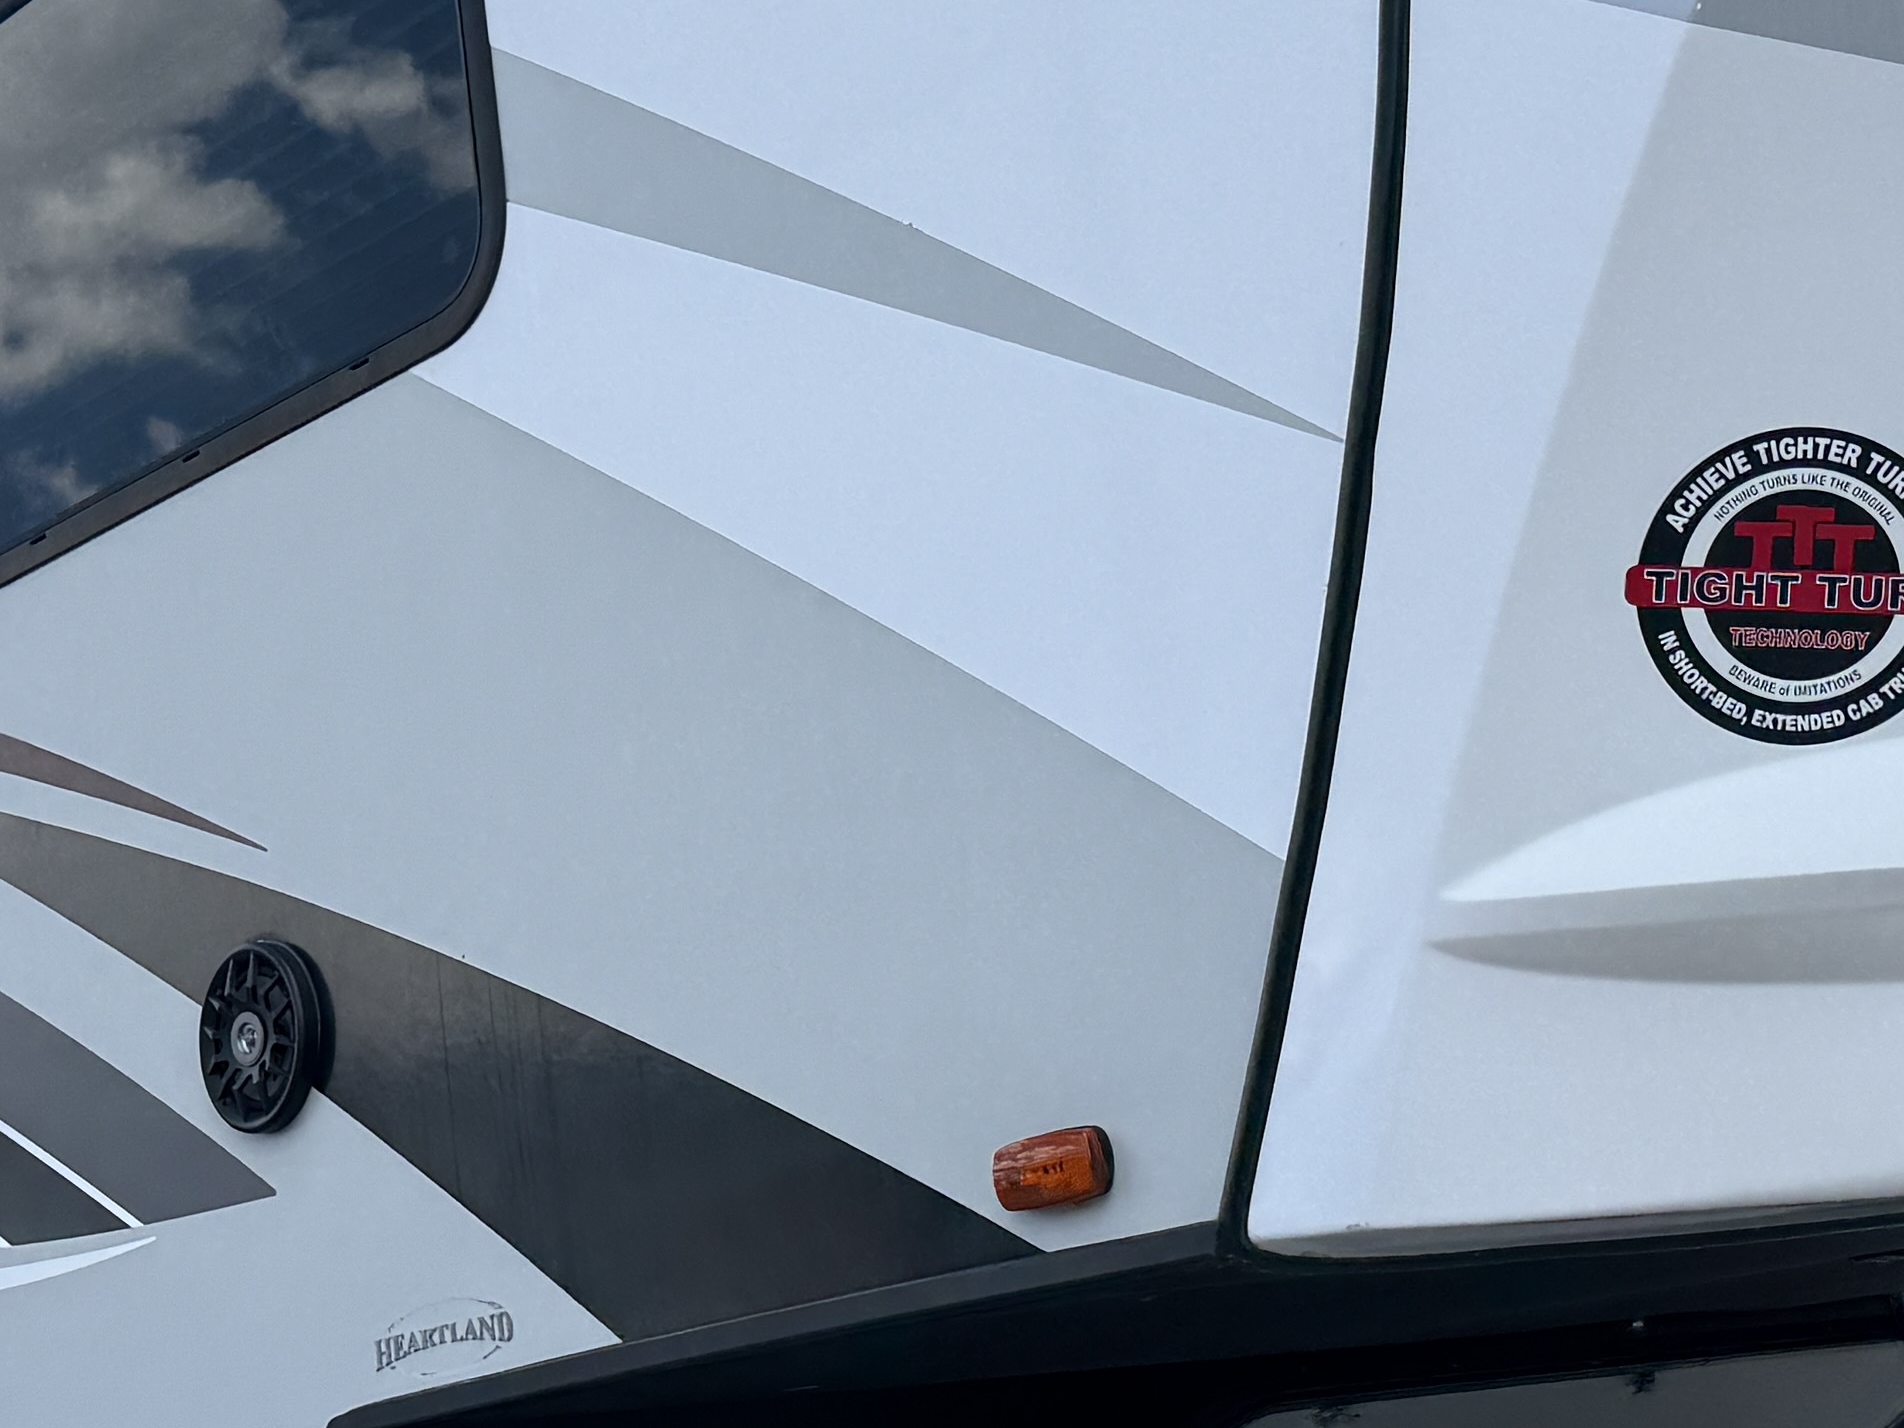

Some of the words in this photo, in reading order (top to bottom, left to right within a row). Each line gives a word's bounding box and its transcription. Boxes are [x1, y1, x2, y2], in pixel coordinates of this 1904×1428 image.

[1665, 449, 1752, 534] ACHIEVE
[1752, 436, 1863, 468] TIGHTER
[1713, 484, 1759, 523] NOTHING
[1759, 474, 1798, 492] TURNS
[1801, 472, 1827, 486] LIKE
[1830, 476, 1852, 493] THE
[1852, 485, 1896, 526] ORIGINAL
[1644, 569, 1803, 607] TIGHT
[1657, 630, 1680, 652] IN
[1729, 626, 1871, 651] TECHNOLOGY
[1668, 649, 1748, 726] SHORT-BED,
[1728, 664, 1777, 695] BEWARE
[1793, 669, 1862, 697] IMITATIONS
[1750, 708, 1846, 732] EXTENDED
[1846, 692, 1884, 721] CAB
[373, 1310, 514, 1373] HEARTLAND
